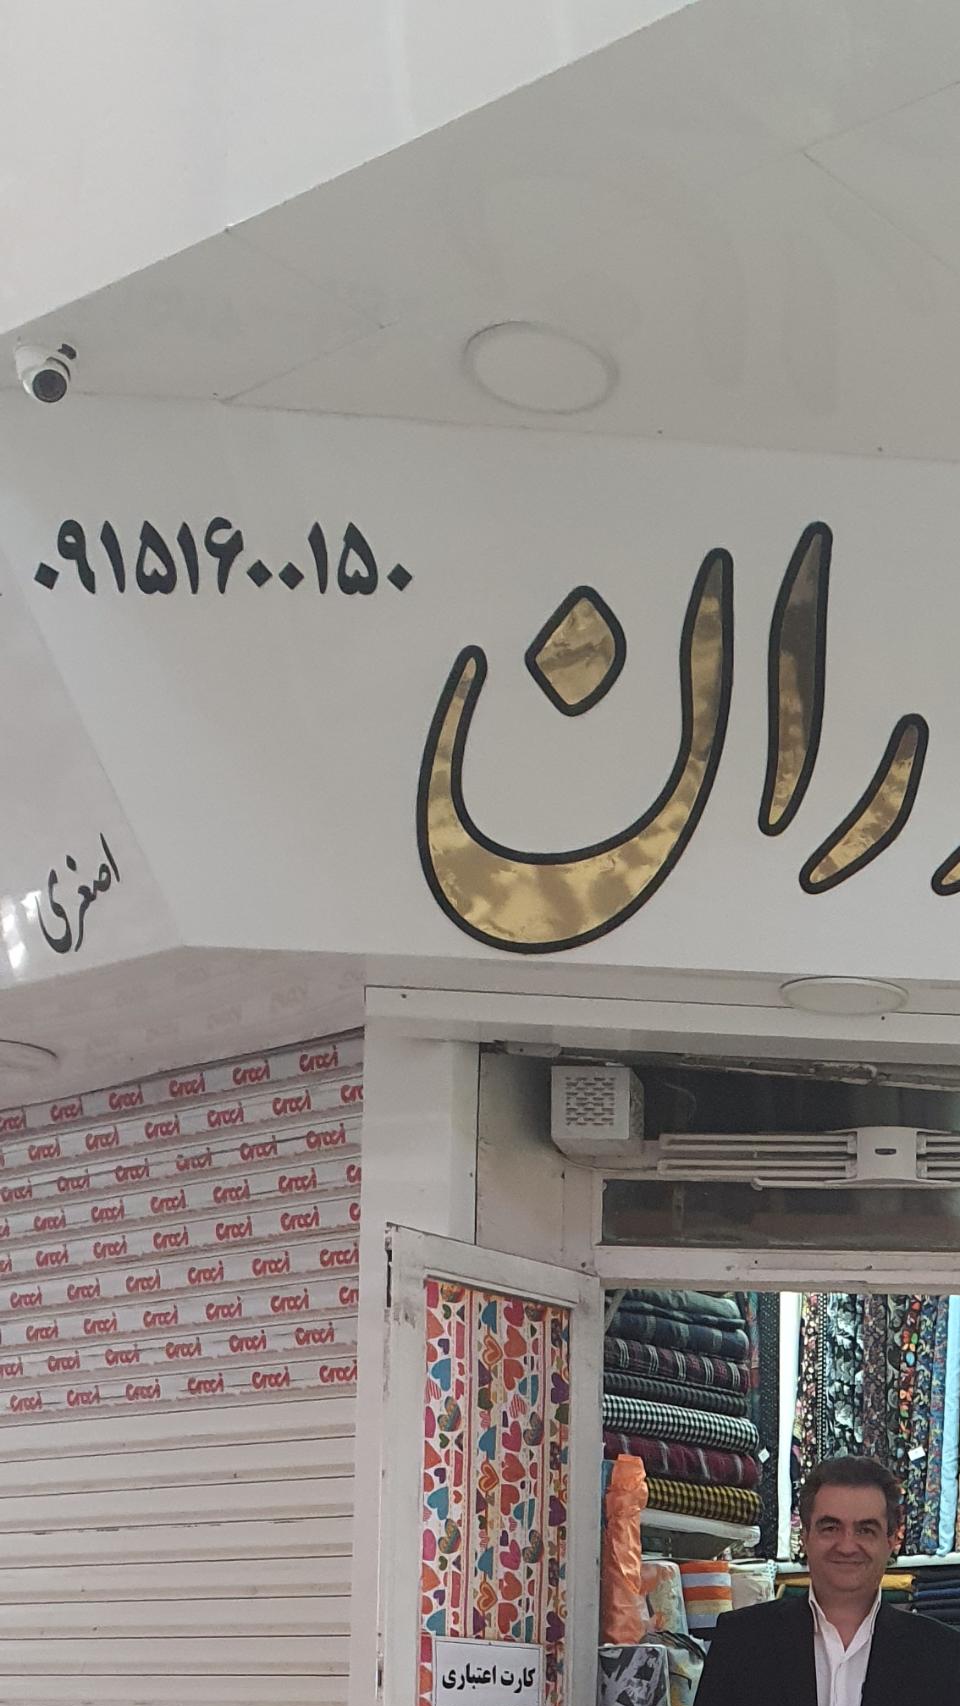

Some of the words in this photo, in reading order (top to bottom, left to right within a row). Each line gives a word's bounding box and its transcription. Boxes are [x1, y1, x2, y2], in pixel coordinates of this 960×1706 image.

[34, 517, 413, 595] ۰۹۱۵۱۶۰۰۱۵۰
[34, 832, 120, 953] اصغری
[442, 1663, 497, 1690] اعتباری
[500, 1666, 536, 1693] کارت
